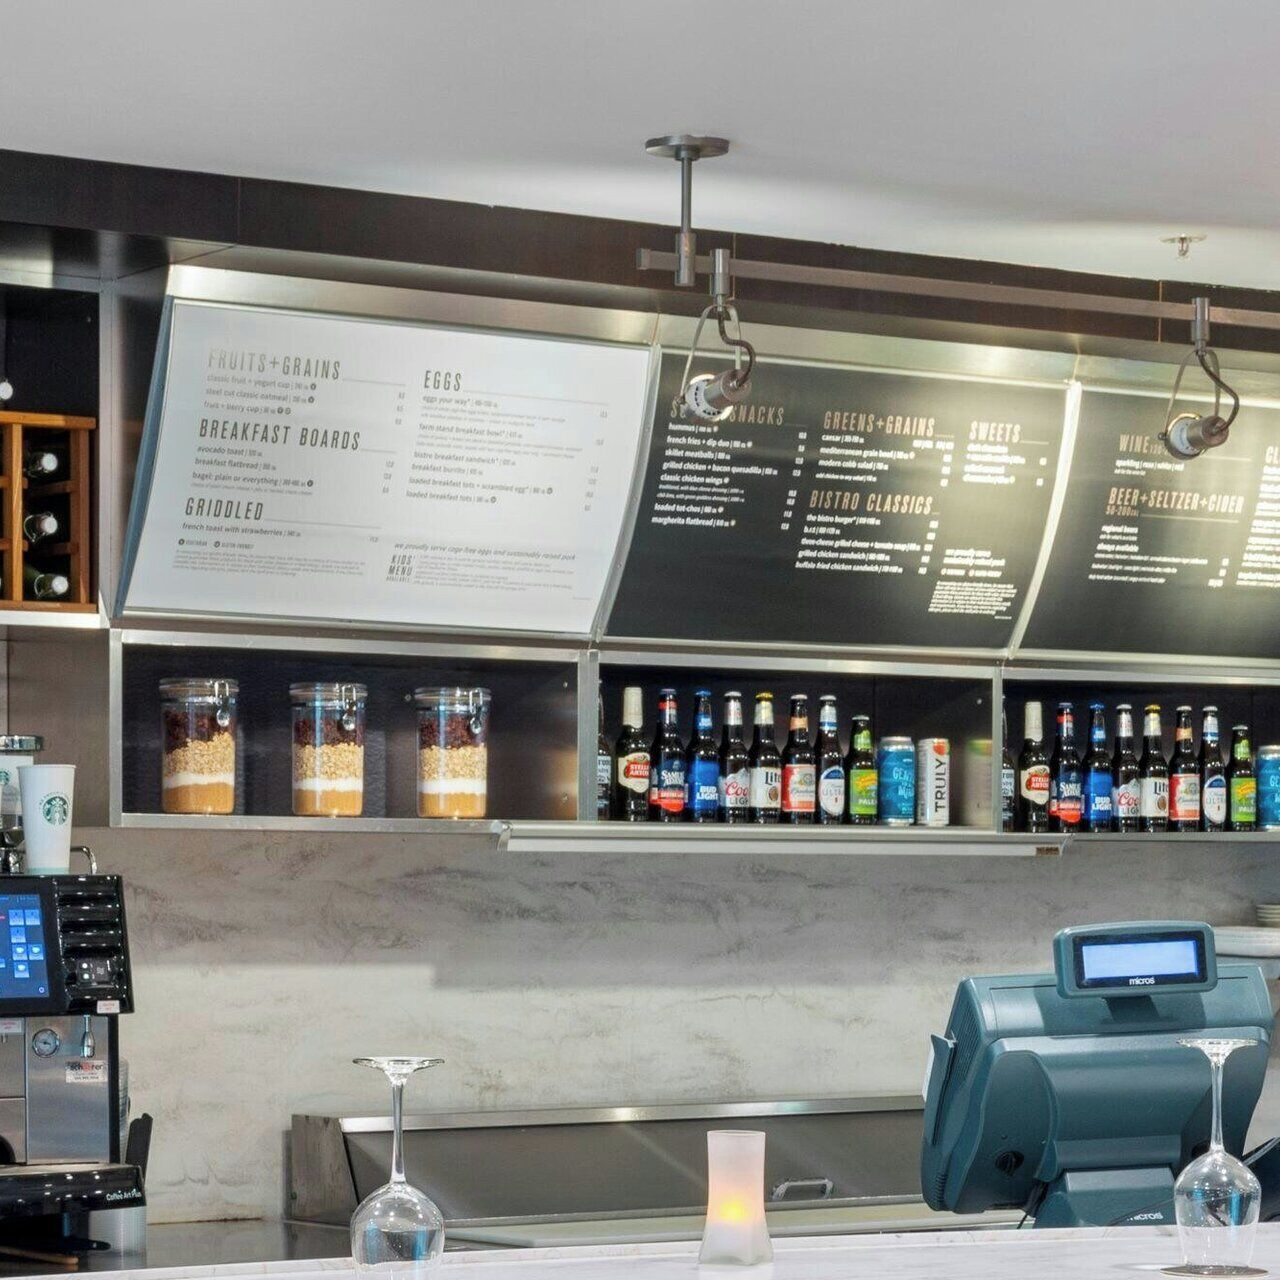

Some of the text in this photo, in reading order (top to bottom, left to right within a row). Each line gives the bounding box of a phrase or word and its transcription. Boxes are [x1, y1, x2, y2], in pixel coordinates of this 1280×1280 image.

[208, 349, 341, 380] FRUITS+GRAINS
[423, 370, 462, 392] EGGS
[728, 404, 784, 426] SNACKS
[823, 410, 935, 438] GREENS+GRAINS
[199, 418, 361, 450] BREAKFAST BOARDS
[456, 426, 485, 436] breakfast
[968, 420, 1021, 443] SWEETS
[1119, 433, 1151, 454] WINE
[195, 458, 226, 467] breakfast
[434, 453, 465, 462] breakfast
[412, 464, 442, 472] breakfast
[242, 476, 278, 486] everything
[432, 479, 462, 488] breakfast
[429, 492, 459, 501] breakfast
[1108, 487, 1245, 514] BEER+SELTZER+CIDER
[809, 490, 933, 515] BISTRO CLASSICS
[185, 497, 264, 521] GRIDDLED
[224, 526, 239, 534] with
[241, 527, 283, 537] strawberries
[388, 565, 413, 577] MENU
[700, 785, 717, 793] BUD
[935, 758, 947, 813] TRULY
[696, 792, 718, 801] LIGHT
[1091, 803, 1112, 811] LIGHT
[1128, 976, 1156, 986] micros
[106, 1191, 123, 1201] Coffee
